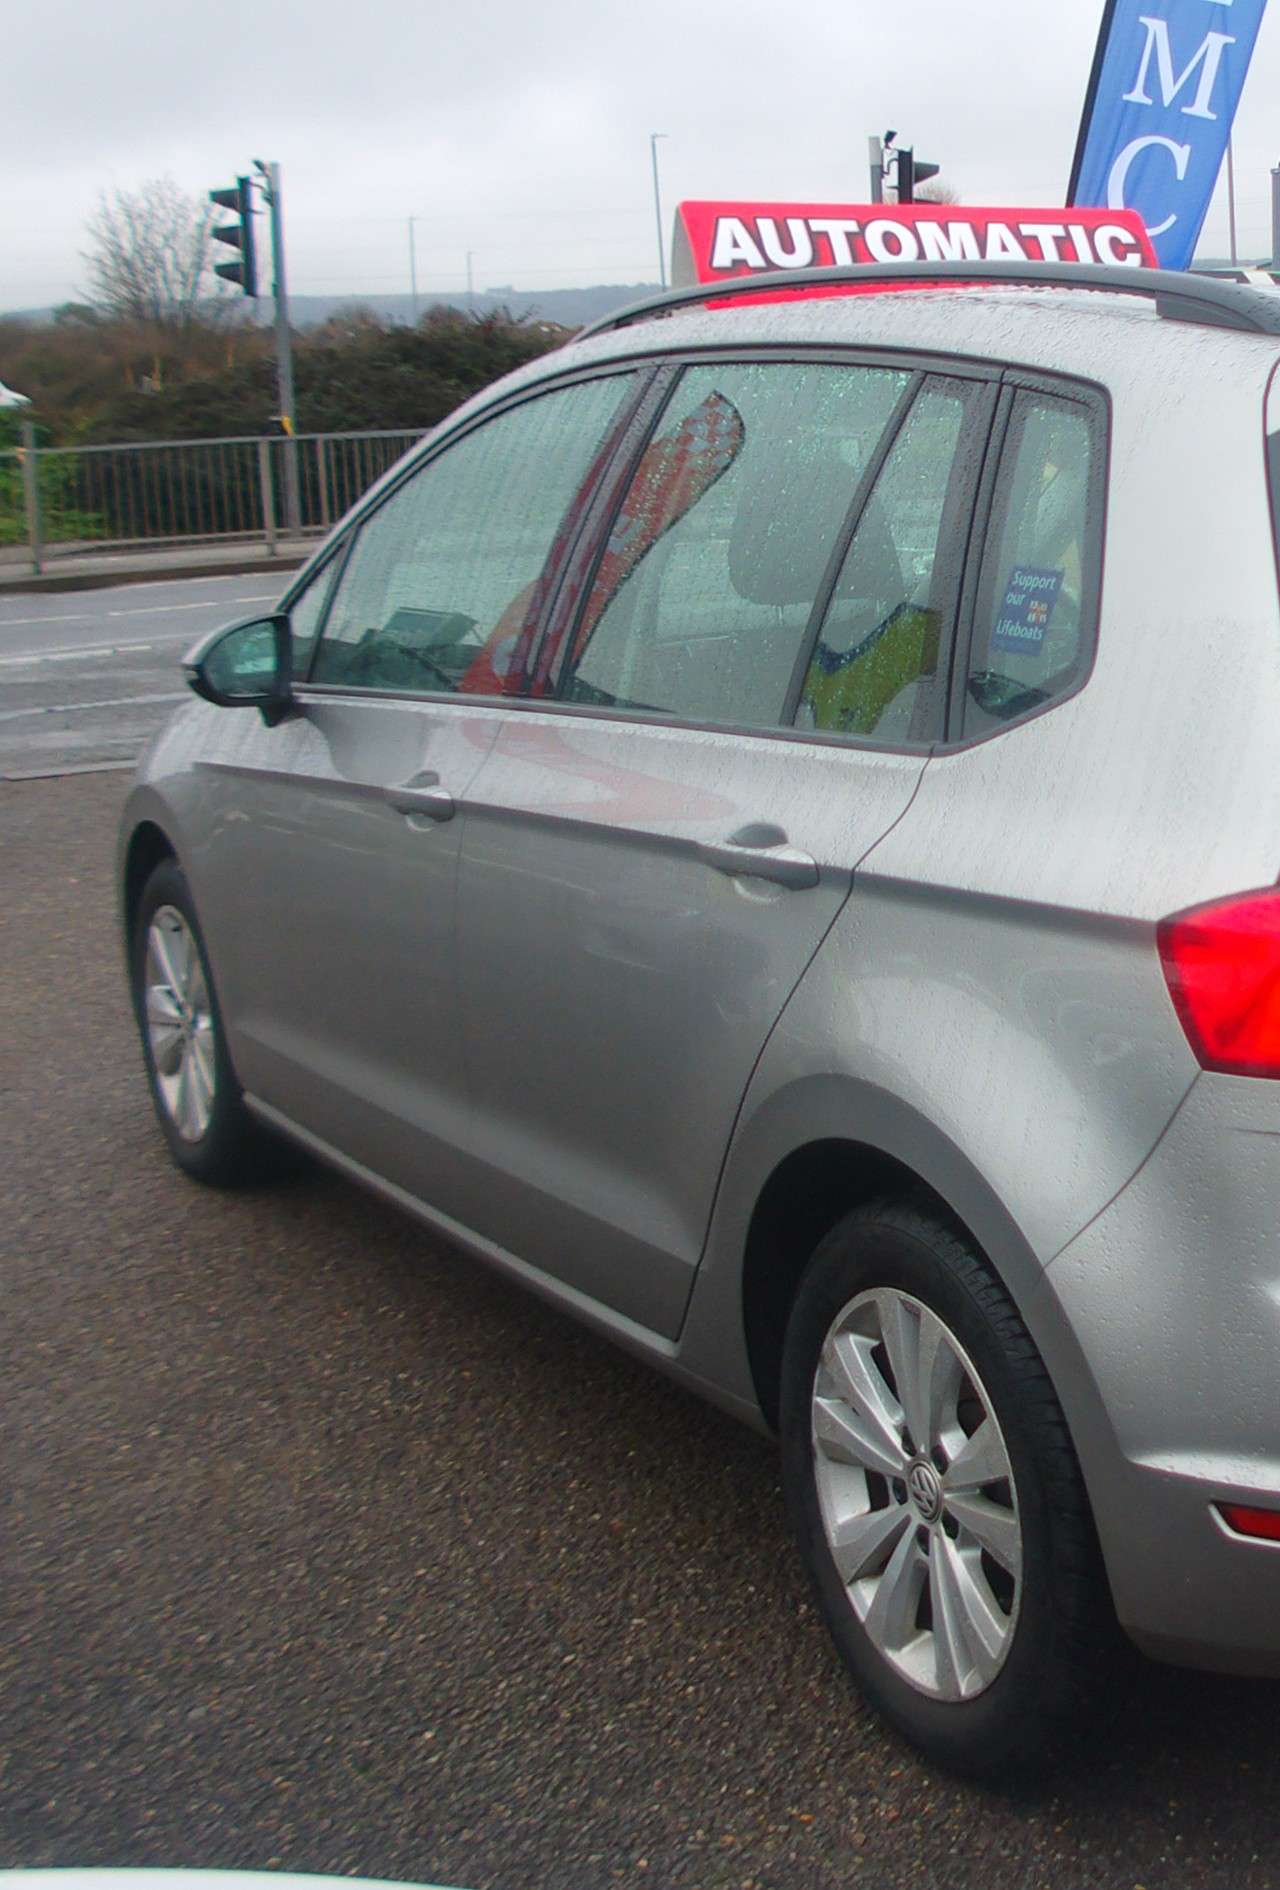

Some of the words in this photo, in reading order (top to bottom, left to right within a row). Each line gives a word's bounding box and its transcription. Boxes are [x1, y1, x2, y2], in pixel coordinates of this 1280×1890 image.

[711, 216, 1142, 269] AUTOMATIC
[1012, 570, 1057, 592] Support
[1006, 592, 1026, 606] our
[996, 620, 1044, 640] Lifeboats
